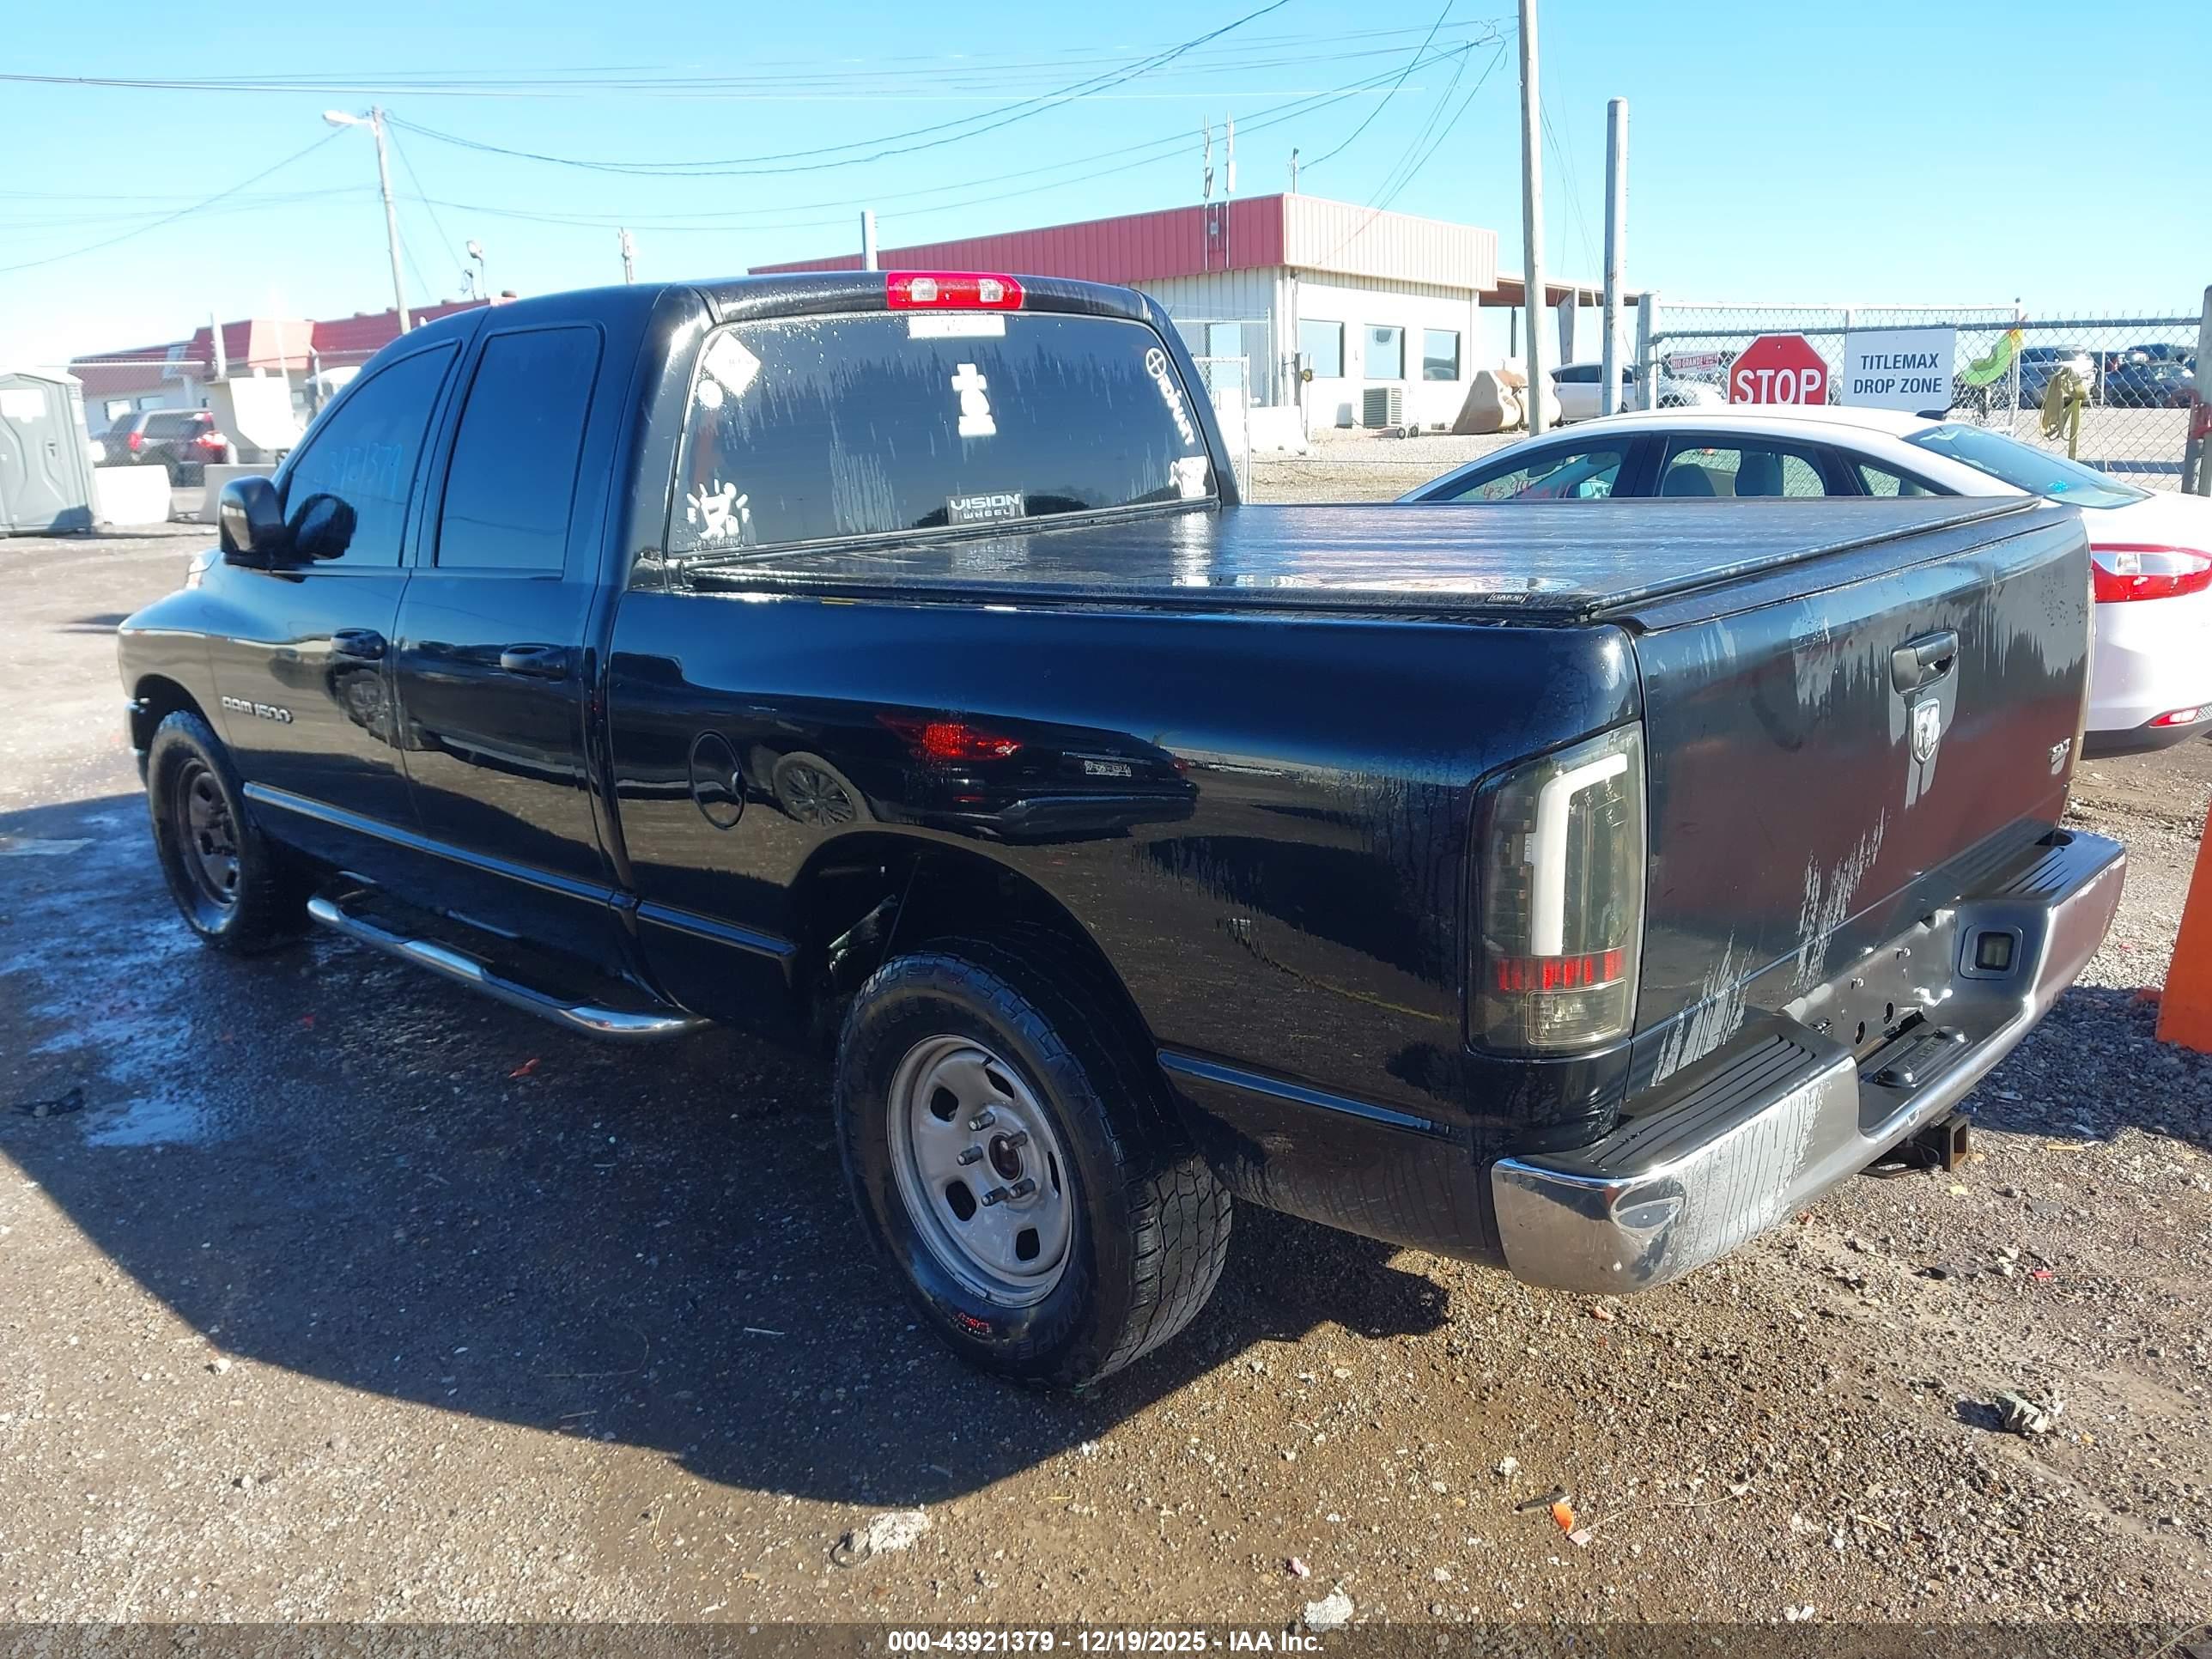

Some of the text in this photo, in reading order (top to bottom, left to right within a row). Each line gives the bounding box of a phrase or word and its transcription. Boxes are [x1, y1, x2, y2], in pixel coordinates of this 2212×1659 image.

[1682, 356, 1703, 368] GRANDE
[1861, 353, 1940, 370] TITLEMAX
[1735, 368, 1822, 404] STOP
[1853, 378, 1942, 395] DROP ZONE
[950, 493, 1021, 511] VISION
[963, 508, 1010, 520] WHEEL
[222, 696, 292, 724] RAM 1500
